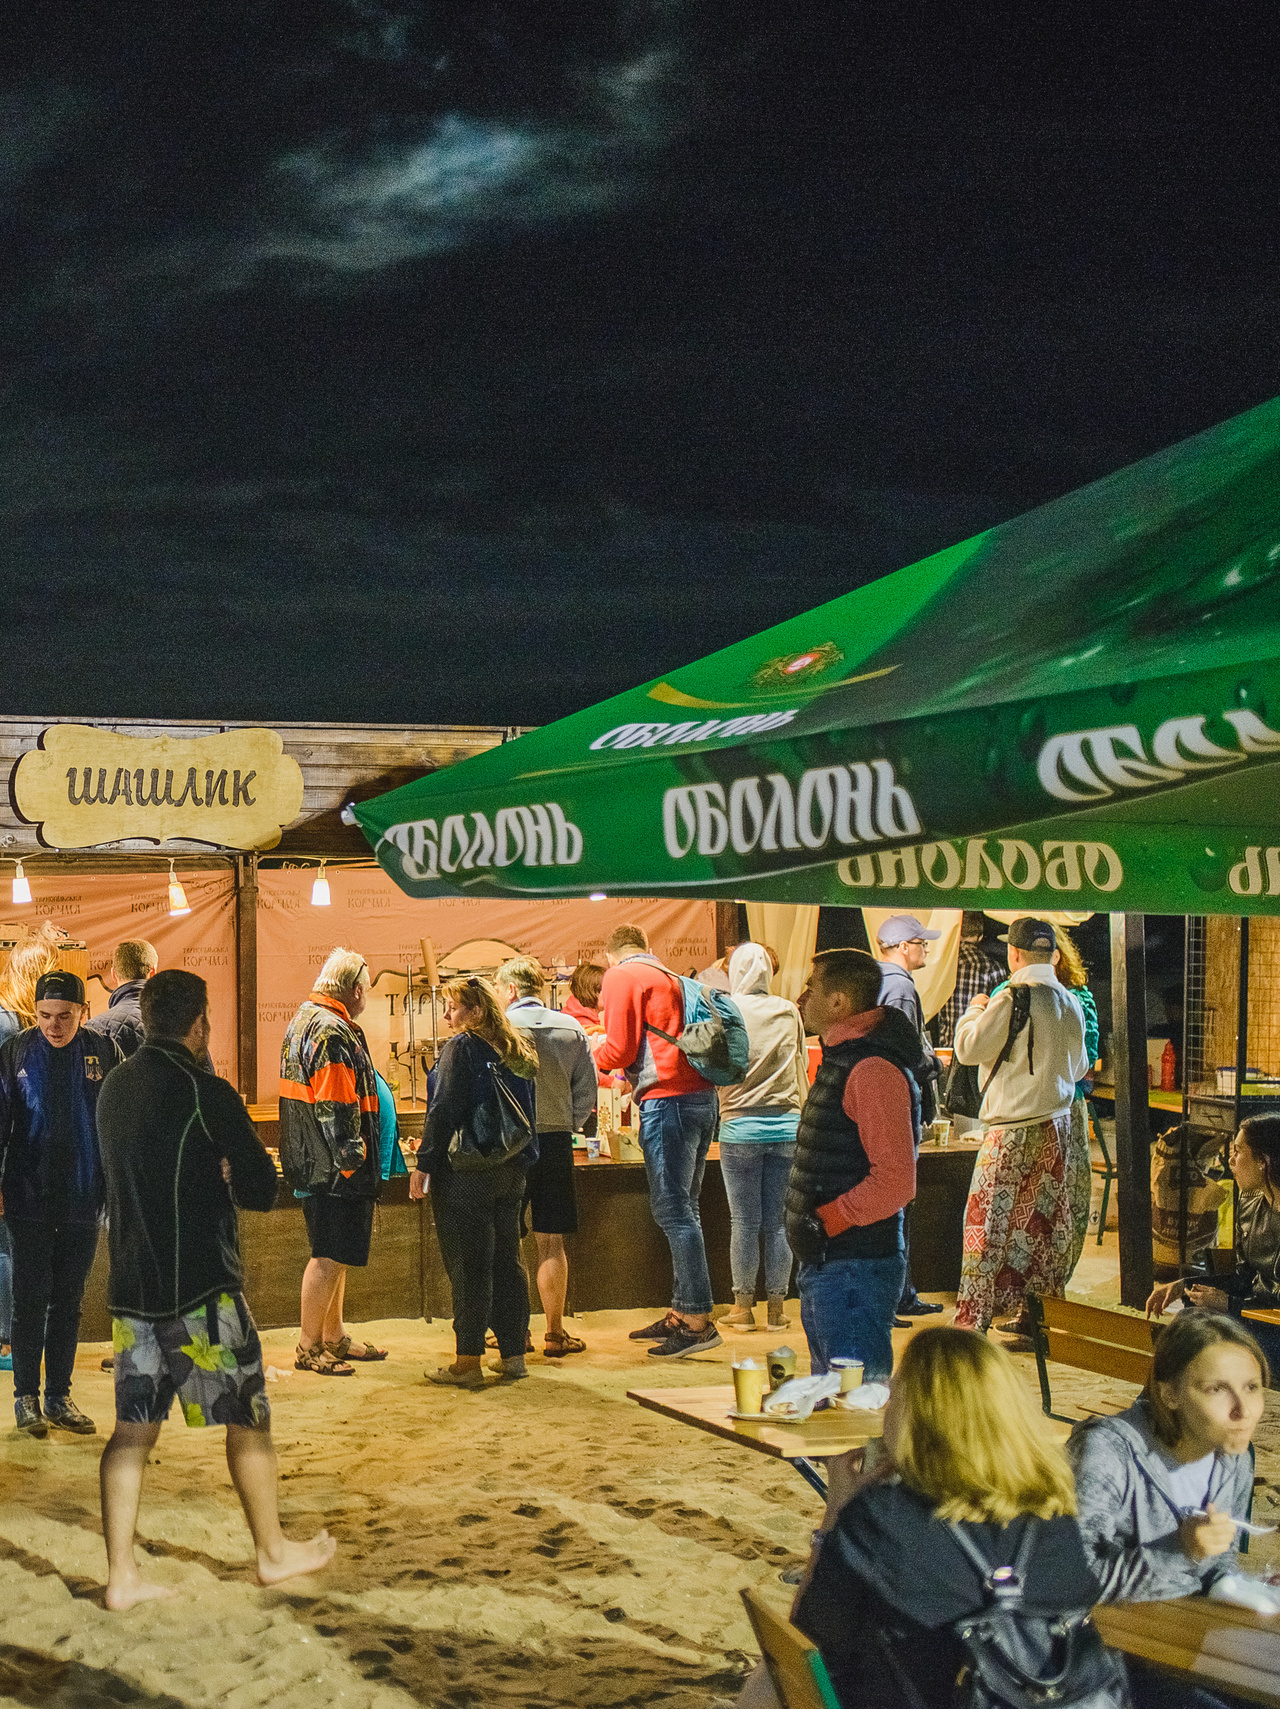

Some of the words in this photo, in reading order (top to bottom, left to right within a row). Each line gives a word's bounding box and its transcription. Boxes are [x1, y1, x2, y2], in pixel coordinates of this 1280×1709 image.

[589, 710, 799, 750] ОБОЛОНЬ
[65, 766, 257, 807] ШАШЛИК
[662, 759, 921, 859] ОБОЛОНЬ
[131, 902, 170, 913] КОРЧМ
